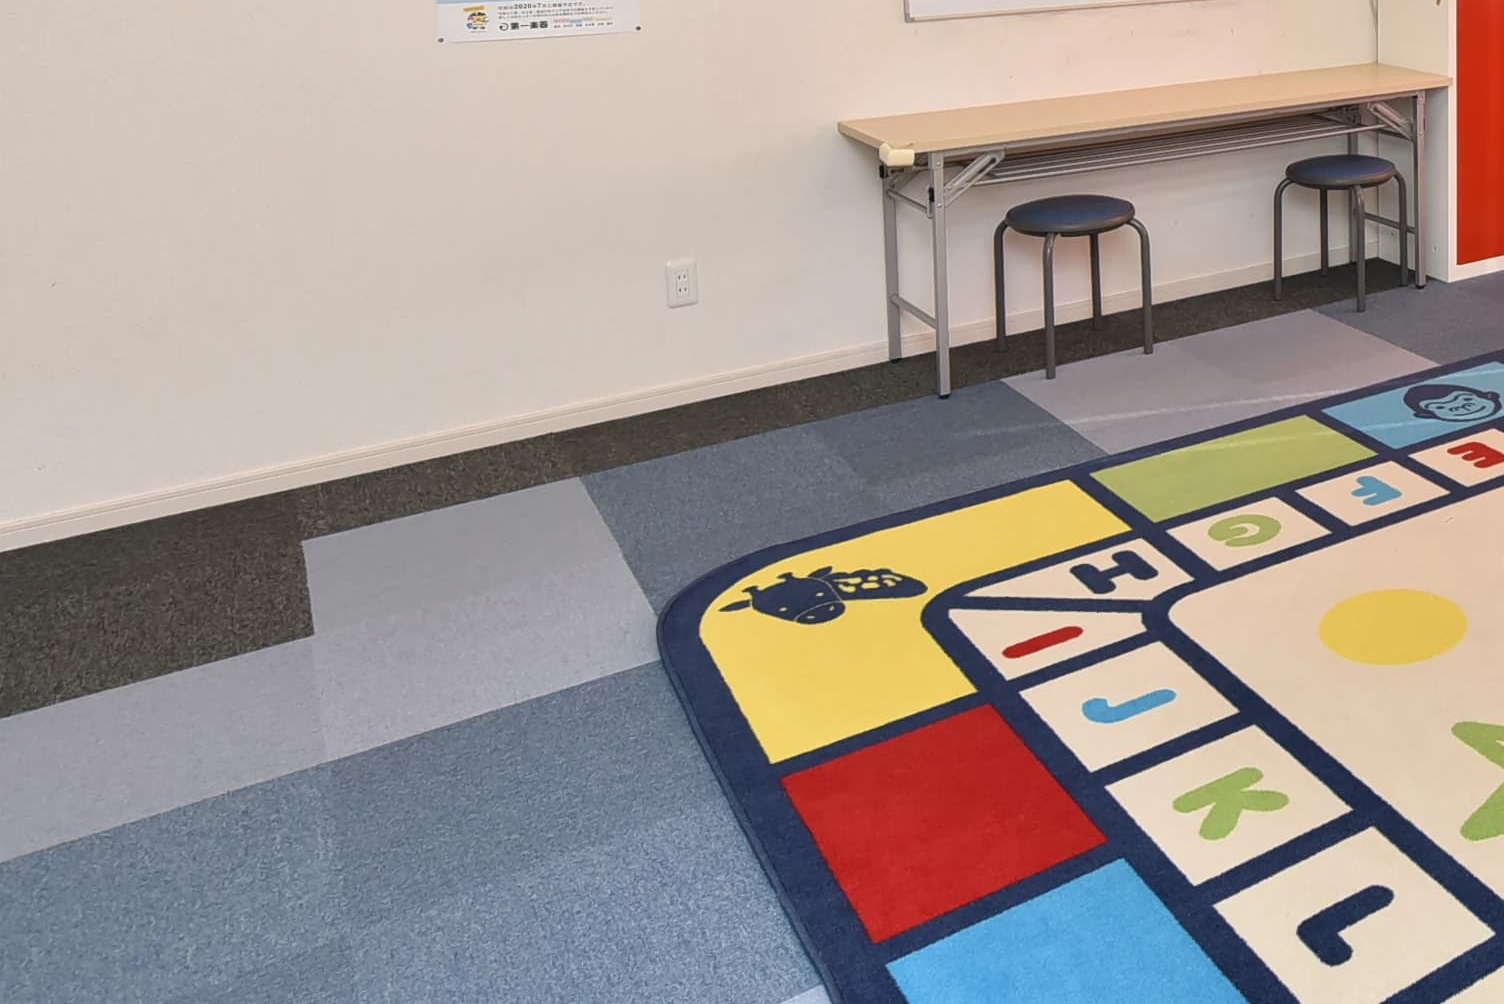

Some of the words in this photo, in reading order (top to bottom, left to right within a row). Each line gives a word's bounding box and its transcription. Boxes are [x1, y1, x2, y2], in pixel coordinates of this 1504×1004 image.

[1351, 476, 1402, 506] F
[1208, 515, 1281, 547] G
[1069, 550, 1159, 595] H
[1082, 689, 1177, 724] J
[1173, 767, 1289, 840] K
[1296, 884, 1395, 968] L
